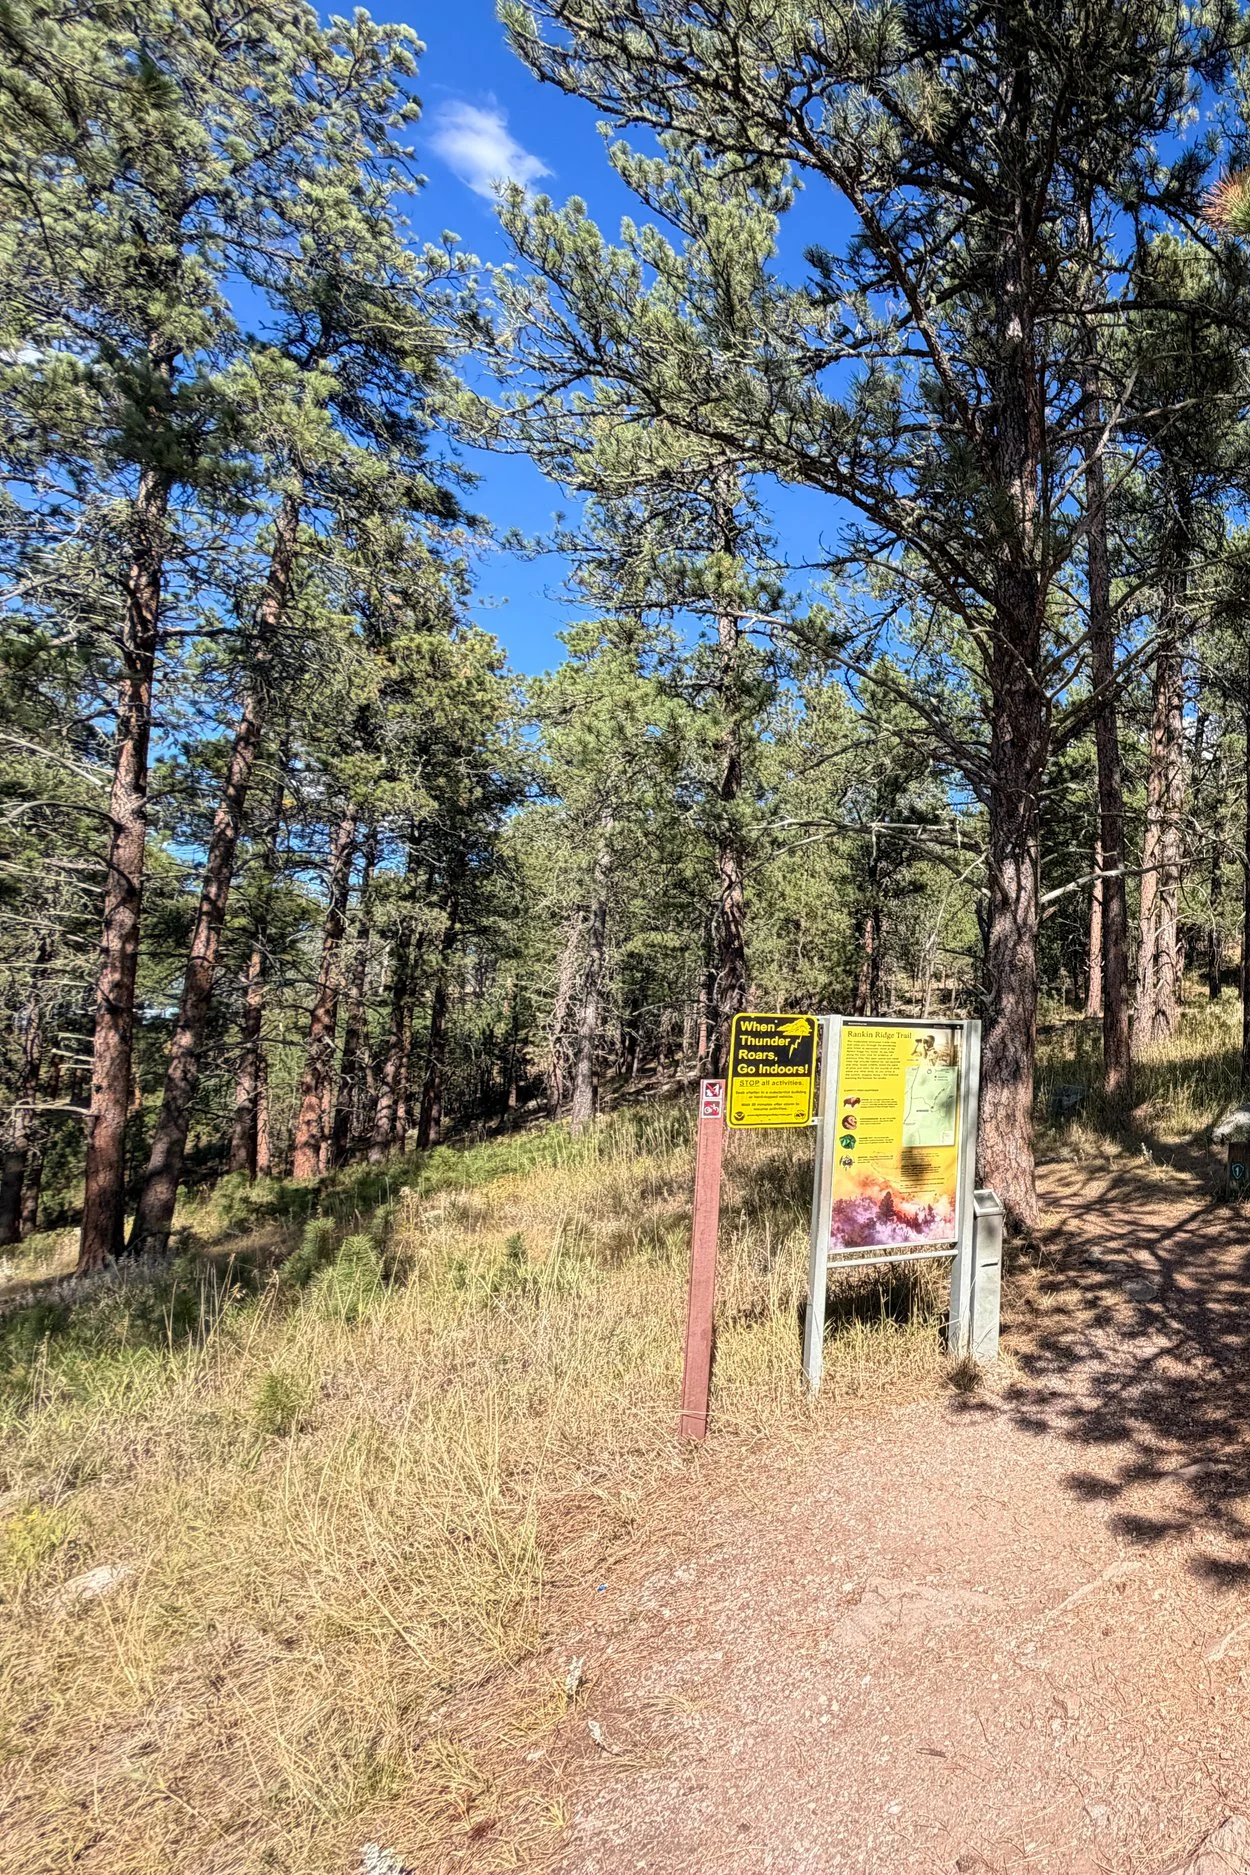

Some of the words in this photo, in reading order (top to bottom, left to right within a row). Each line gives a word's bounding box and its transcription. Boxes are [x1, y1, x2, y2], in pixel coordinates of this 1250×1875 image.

[740, 1021, 775, 1032] When
[739, 1035, 791, 1046] Thunder
[847, 1030, 873, 1038] Rankin
[875, 1031, 895, 1040] Ridge
[896, 1031, 912, 1039] Trail
[738, 1049, 778, 1062] Roars,
[737, 1063, 756, 1074] Go
[758, 1063, 809, 1074] Indoors!
[739, 1079, 760, 1087] STOP
